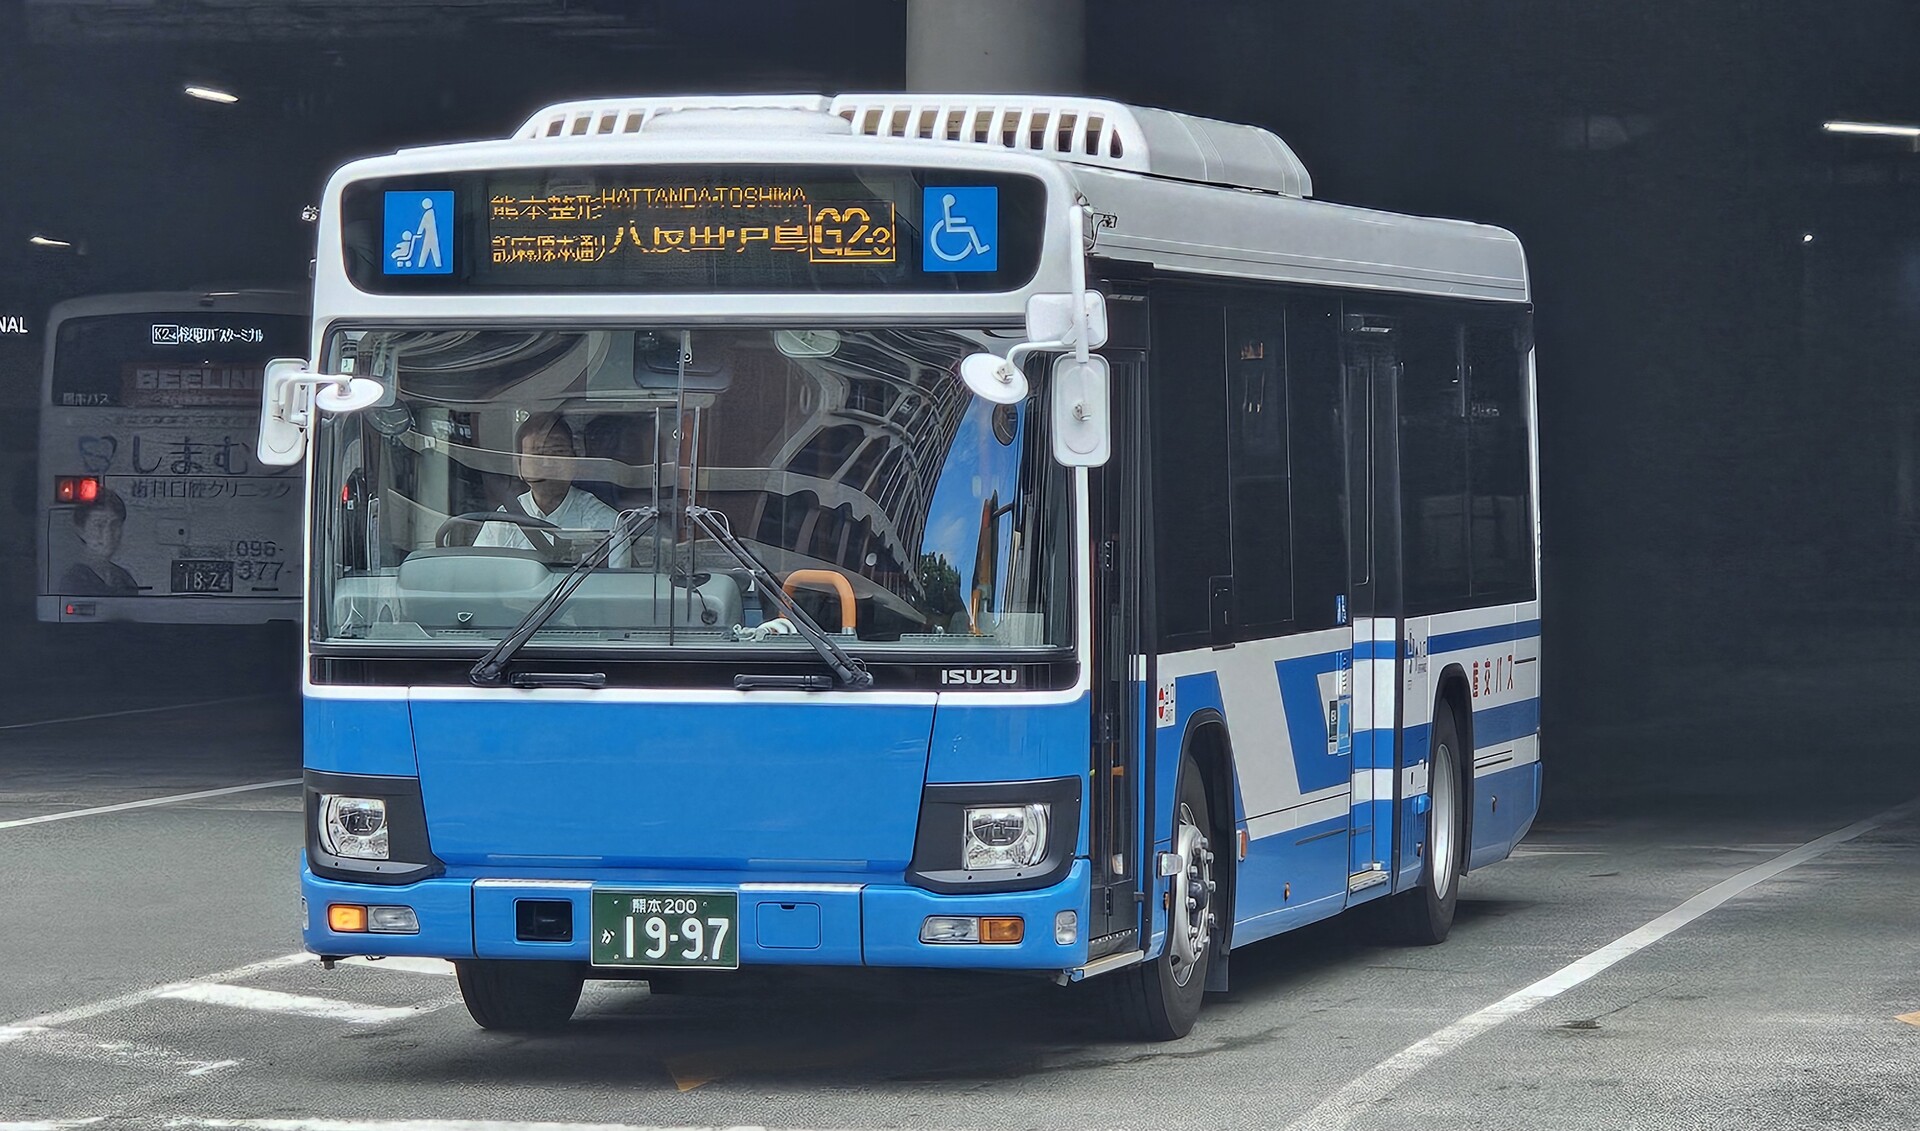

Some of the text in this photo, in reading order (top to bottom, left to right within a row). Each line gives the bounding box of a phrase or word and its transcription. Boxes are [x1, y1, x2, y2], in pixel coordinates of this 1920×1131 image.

[132, 434, 290, 476] しまむ
[941, 669, 1018, 684] ISUZU
[624, 916, 730, 960] 19-97
